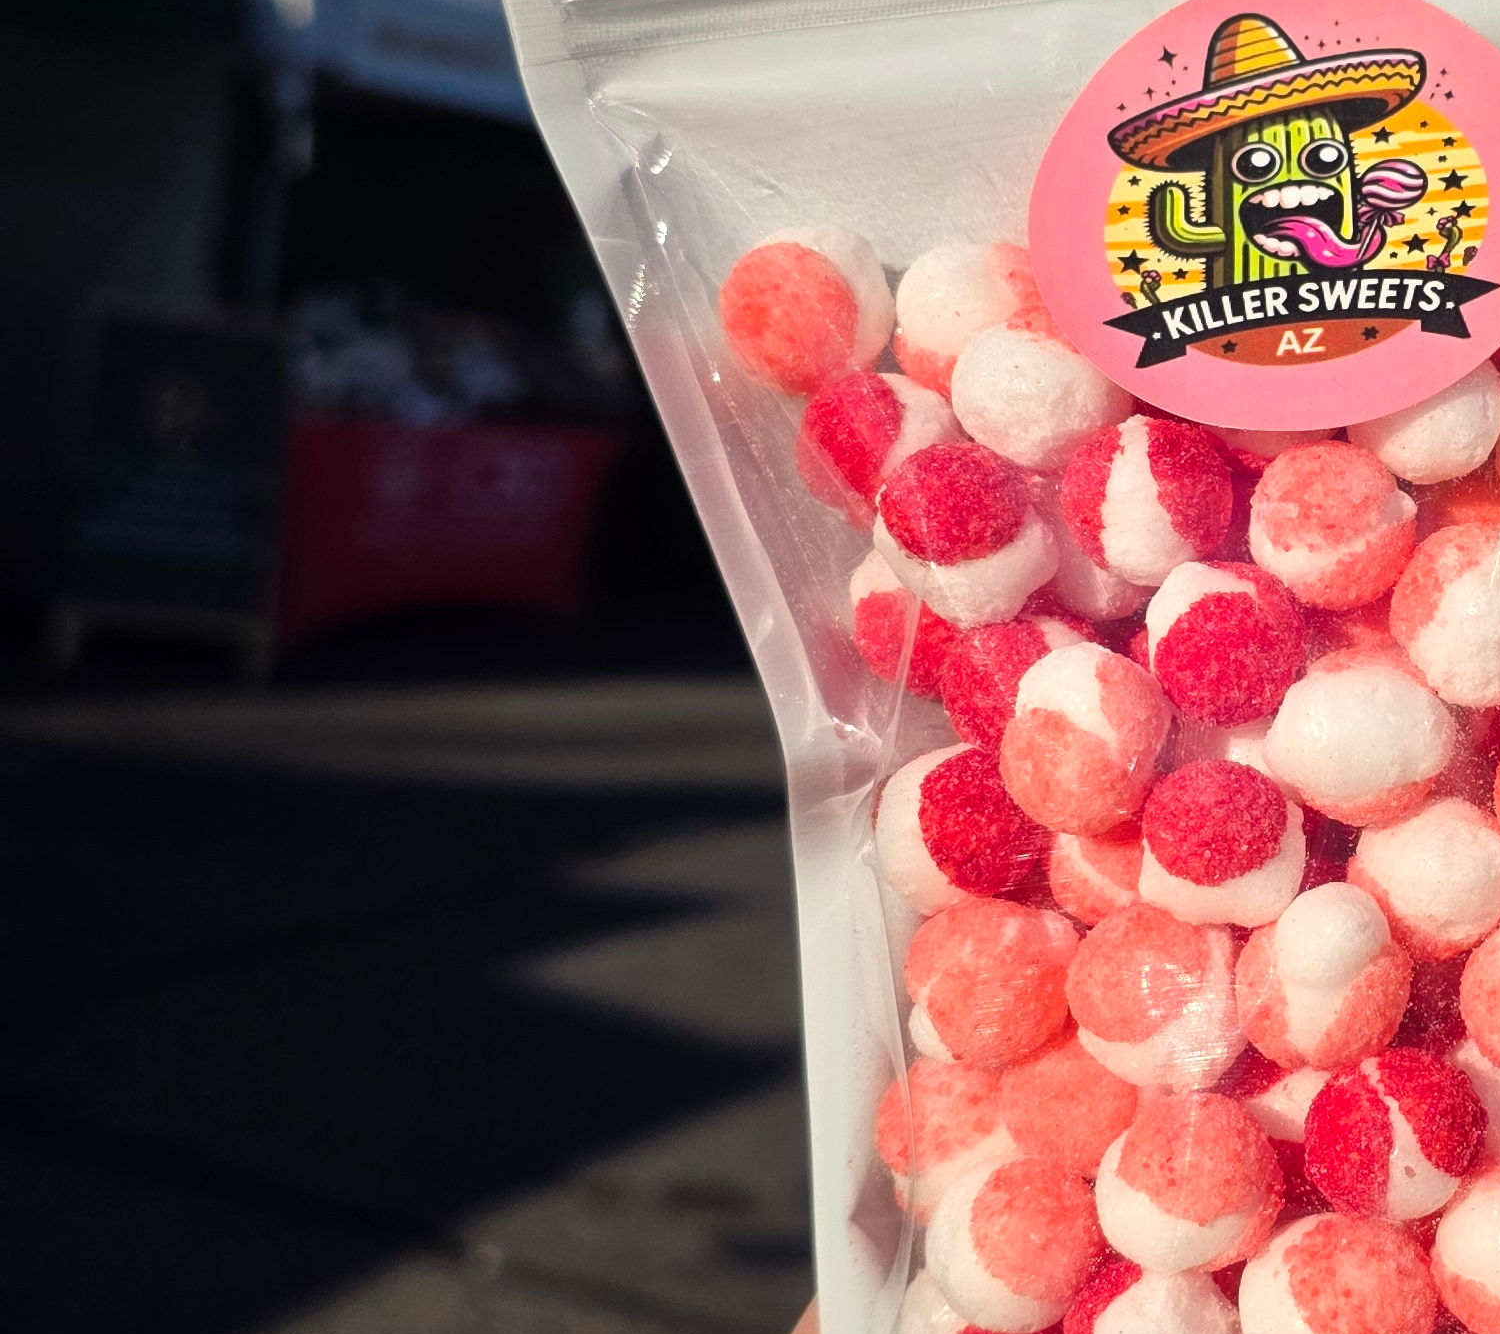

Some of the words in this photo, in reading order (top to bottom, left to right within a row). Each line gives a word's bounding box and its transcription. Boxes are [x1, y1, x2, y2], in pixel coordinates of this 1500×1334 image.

[1161, 286, 1288, 340] KILLER
[1299, 278, 1445, 312] SWEETS
[1276, 327, 1325, 356] AZ
